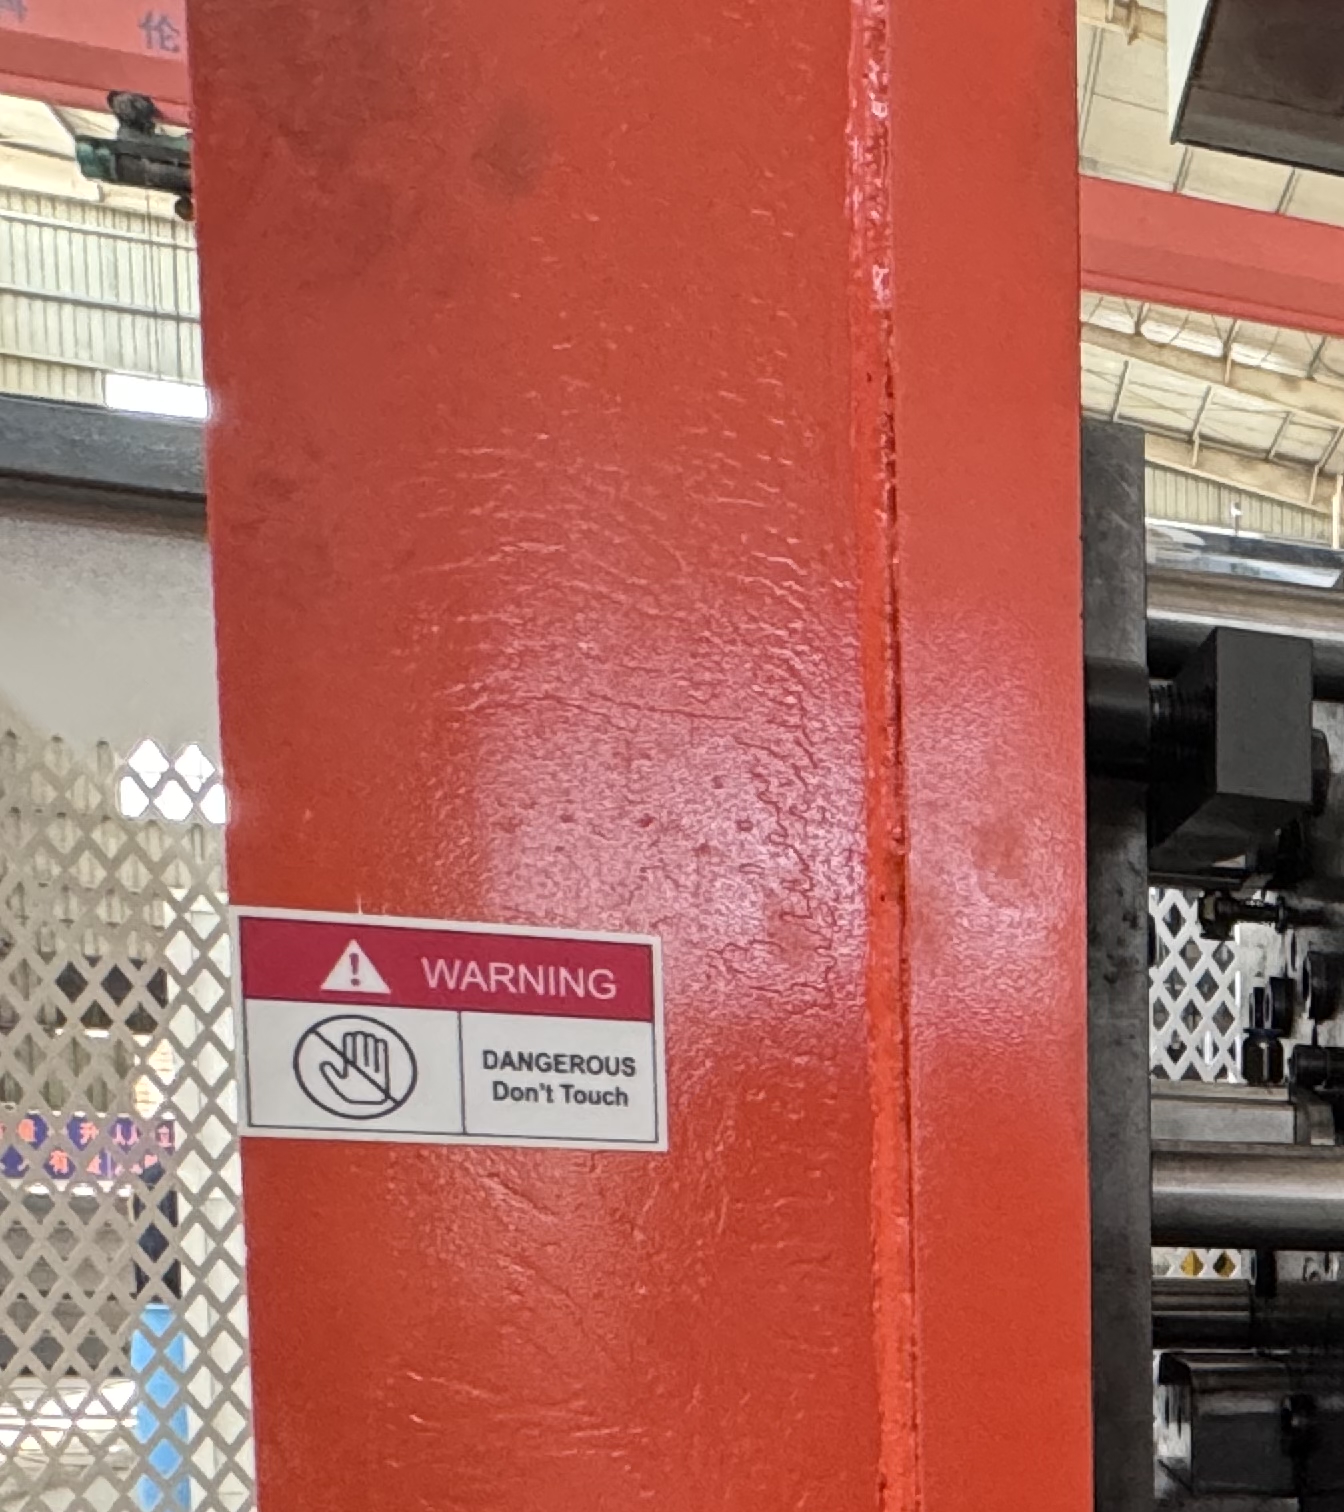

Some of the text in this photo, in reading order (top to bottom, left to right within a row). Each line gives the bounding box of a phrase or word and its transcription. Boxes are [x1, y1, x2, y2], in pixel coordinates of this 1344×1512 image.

[421, 956, 618, 1000] WARNING
[482, 1049, 637, 1077] DANGEROUS
[492, 1080, 629, 1107] Don't Touch
